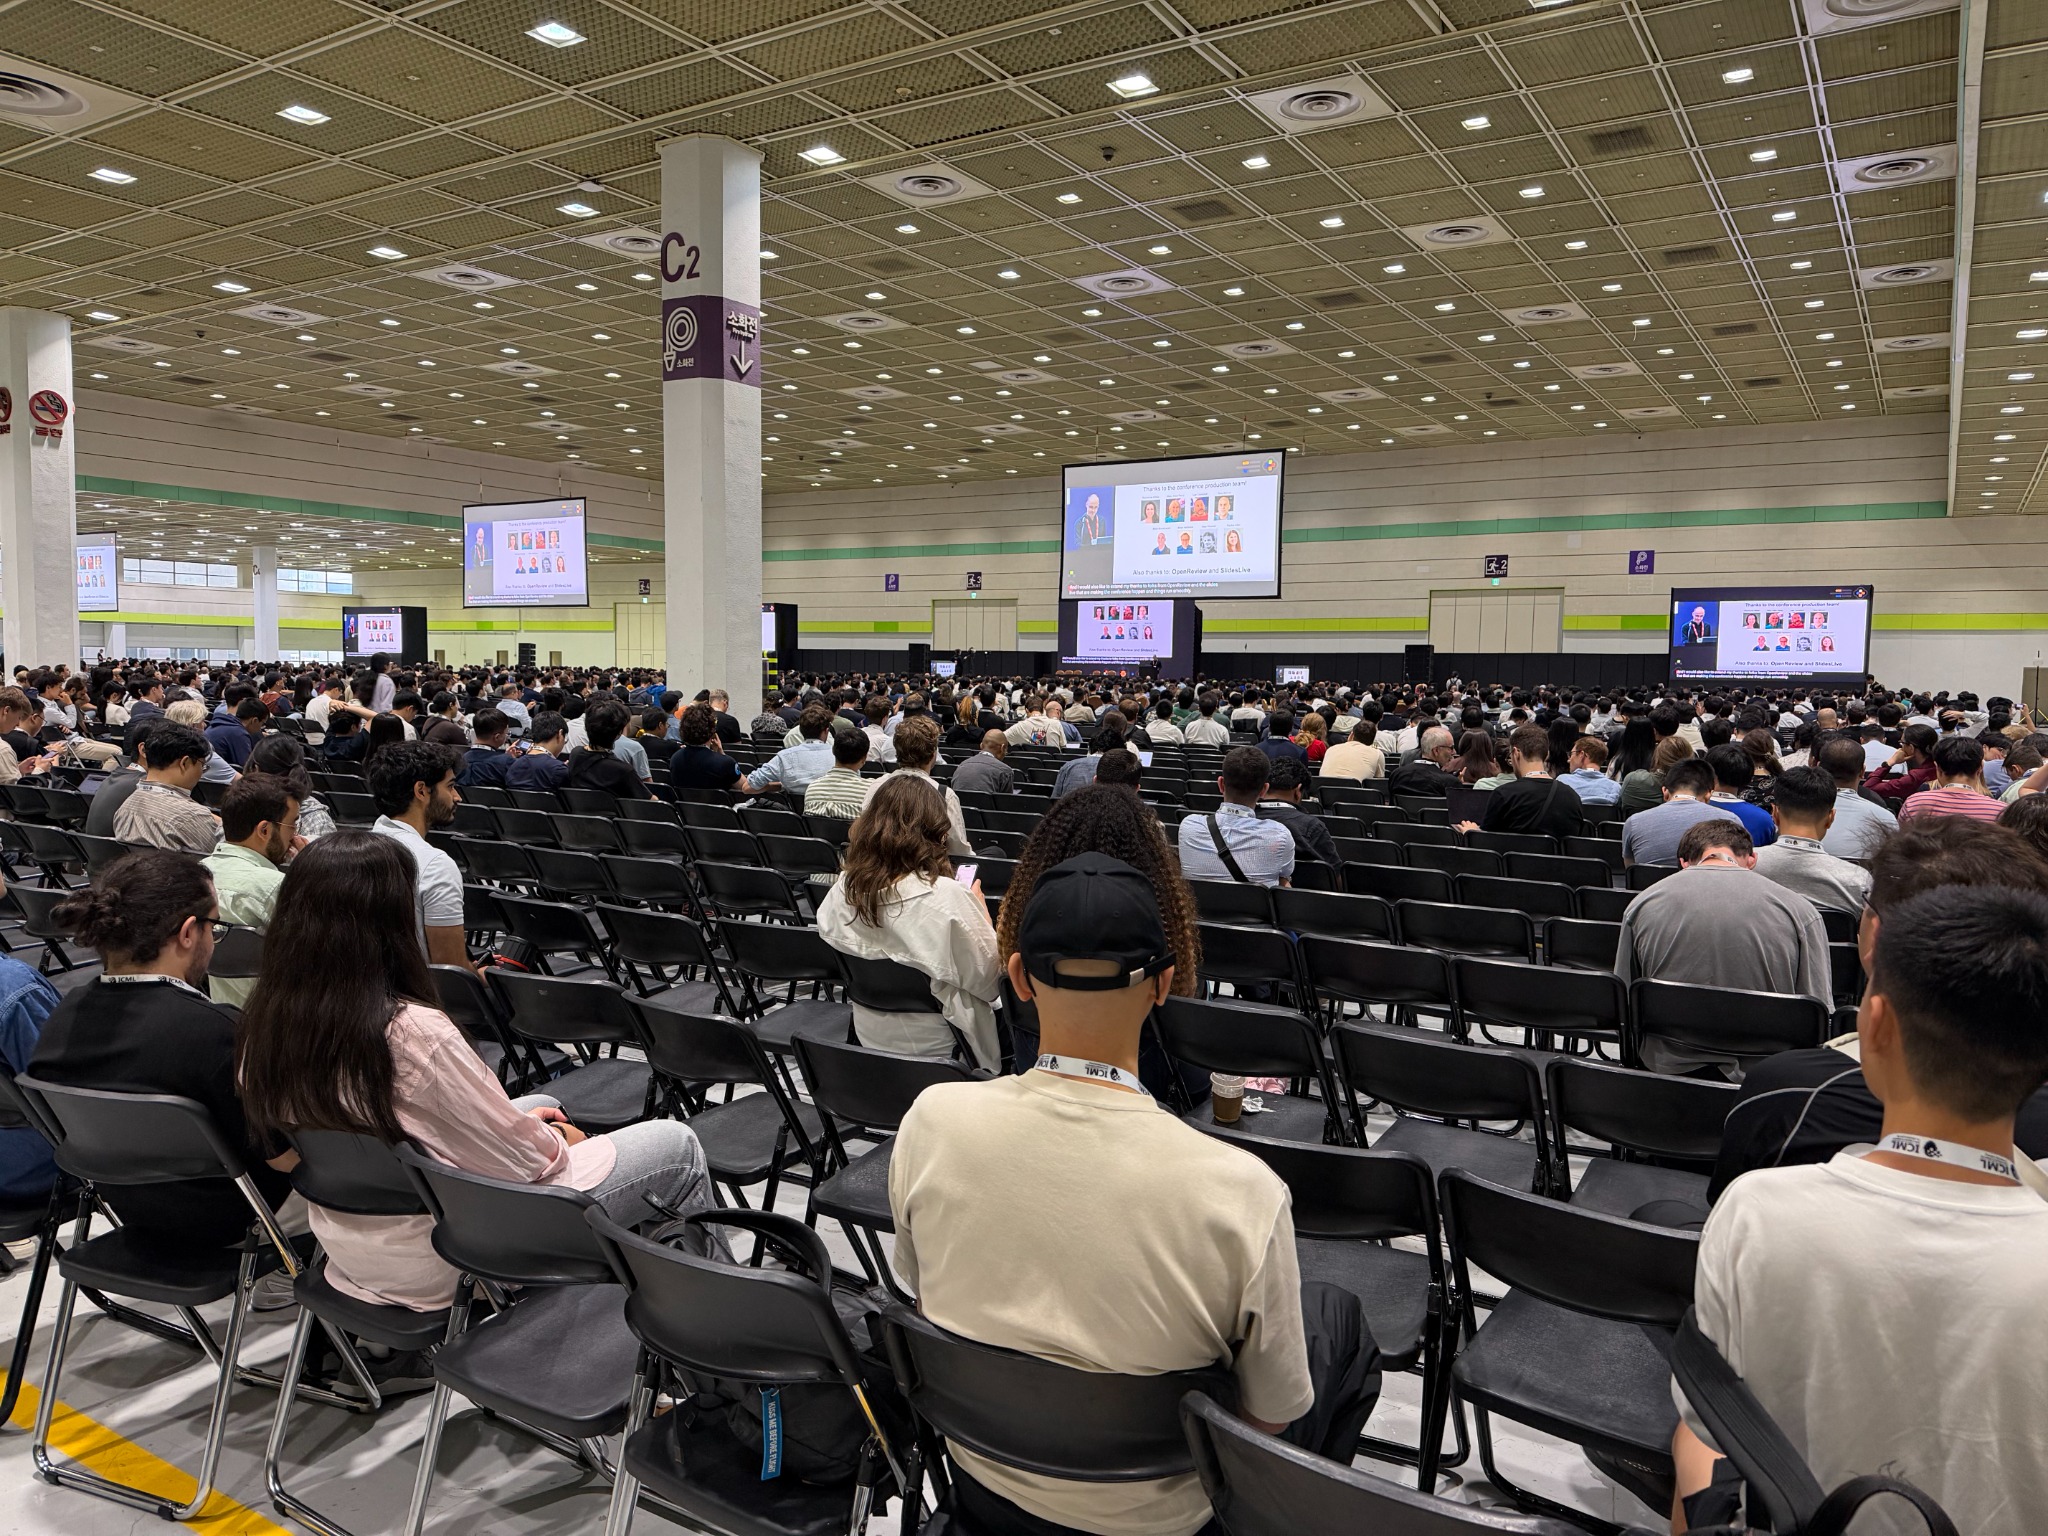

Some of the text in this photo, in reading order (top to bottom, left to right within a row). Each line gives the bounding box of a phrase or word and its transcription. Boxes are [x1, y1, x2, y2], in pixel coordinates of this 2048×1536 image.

[661, 232, 700, 282] C2
[728, 311, 758, 333] 소화전
[676, 358, 694, 367] 소화전
[35, 426, 63, 438] 금연
[1205, 482, 1232, 490] production
[1501, 560, 1507, 569] 2
[1171, 568, 1208, 576] OpenReview
[1085, 1066, 1108, 1078] ICML
[1891, 1140, 1920, 1153] ICML
[1980, 1159, 2009, 1175] ICML
[768, 1401, 778, 1473] KISS ME BEFORE FLIGHT
